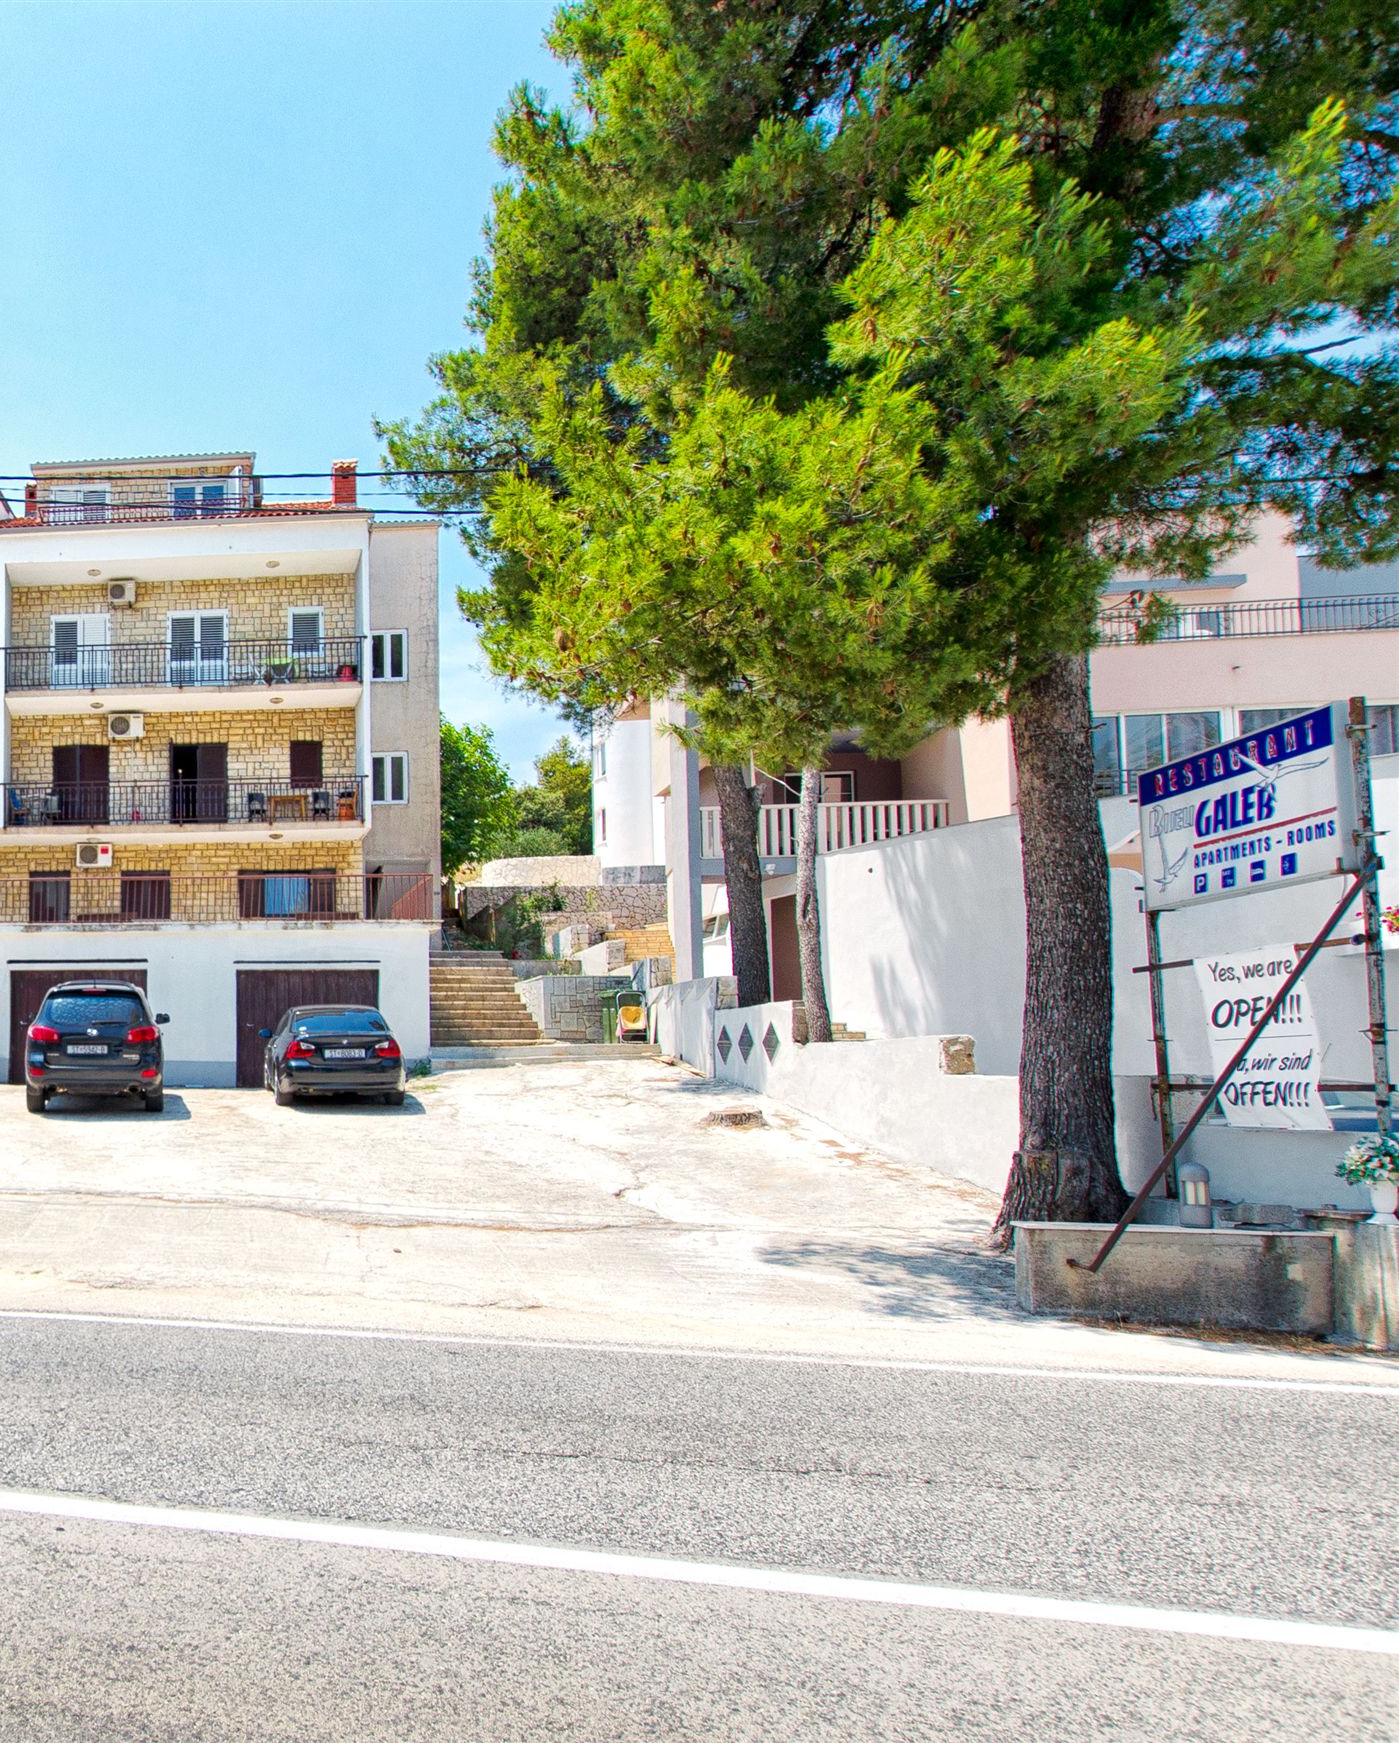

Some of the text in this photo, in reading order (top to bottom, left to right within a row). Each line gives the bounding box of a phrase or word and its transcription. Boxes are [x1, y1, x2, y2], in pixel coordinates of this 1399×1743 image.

[1153, 719, 1314, 797] RESTAURANT
[1194, 783, 1277, 838] GALEB
[1193, 836, 1272, 869] APARTMENTS
[1287, 819, 1337, 847] ROOMS
[1207, 958, 1293, 984] Yes, we are
[1251, 1052, 1277, 1070] wir
[1278, 1048, 1313, 1071] sind
[1223, 1080, 1311, 1108] OFFEN!!!
